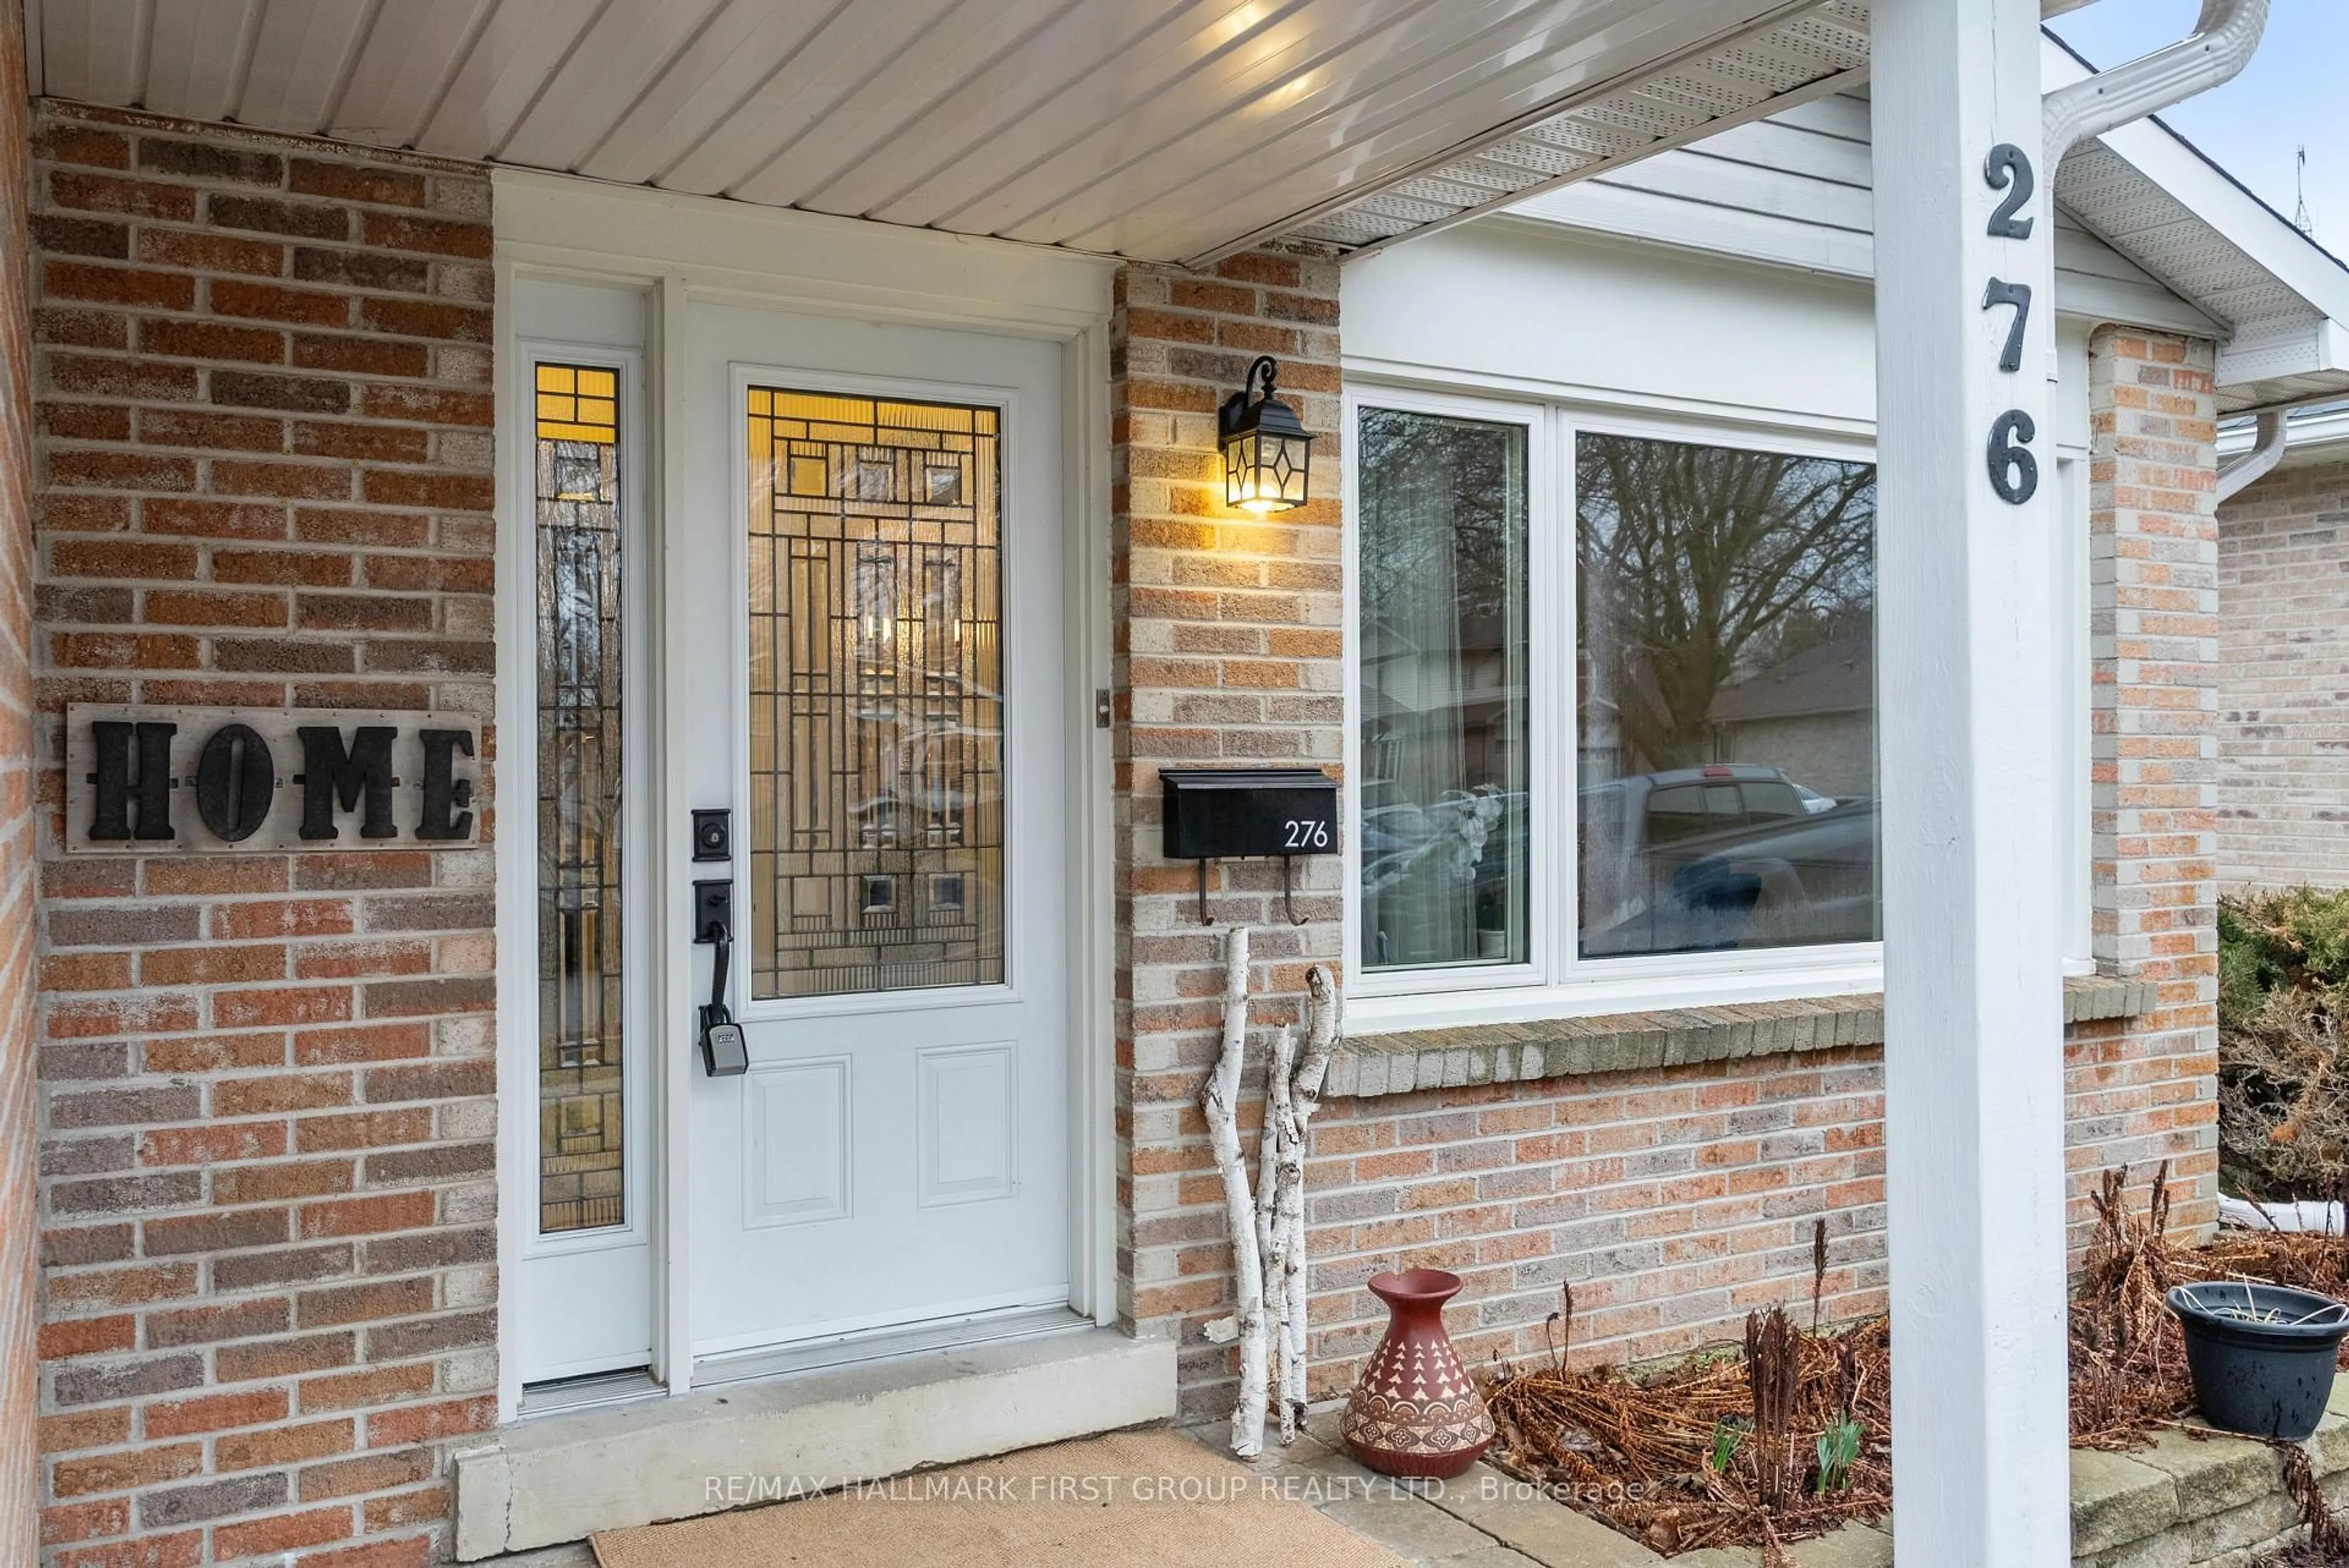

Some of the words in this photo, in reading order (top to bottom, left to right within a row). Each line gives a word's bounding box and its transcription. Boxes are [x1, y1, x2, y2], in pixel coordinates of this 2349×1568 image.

[1983, 143, 2038, 506] 276
[88, 721, 475, 841] HOME
[1285, 821, 1328, 847] 276
